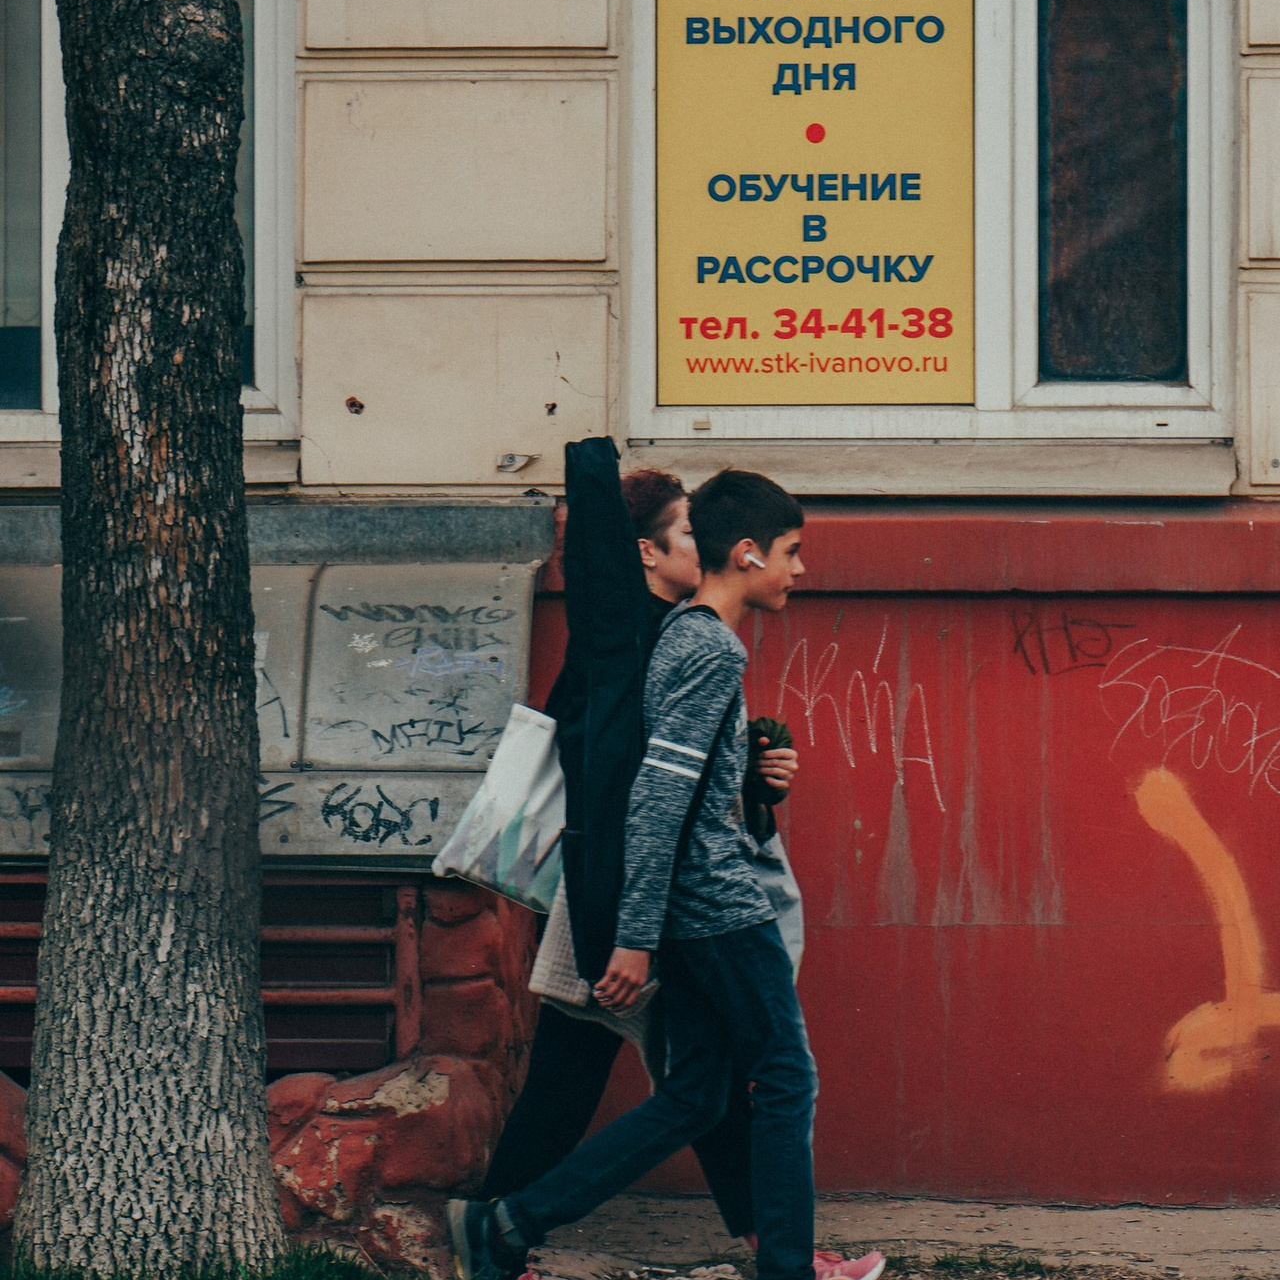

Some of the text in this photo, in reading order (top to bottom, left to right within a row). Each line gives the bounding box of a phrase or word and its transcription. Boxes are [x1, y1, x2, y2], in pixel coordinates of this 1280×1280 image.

[686, 16, 944, 48] ВЫХОДНОГО
[772, 63, 856, 95] ДНЯ
[708, 173, 921, 202] ОБУЧЕНИЕ
[803, 215, 827, 242] В
[697, 255, 934, 283] РАССРОЧКУ
[680, 307, 953, 340] тел. 34-41-38
[686, 352, 948, 374] www.stk-ivanovo.ru
